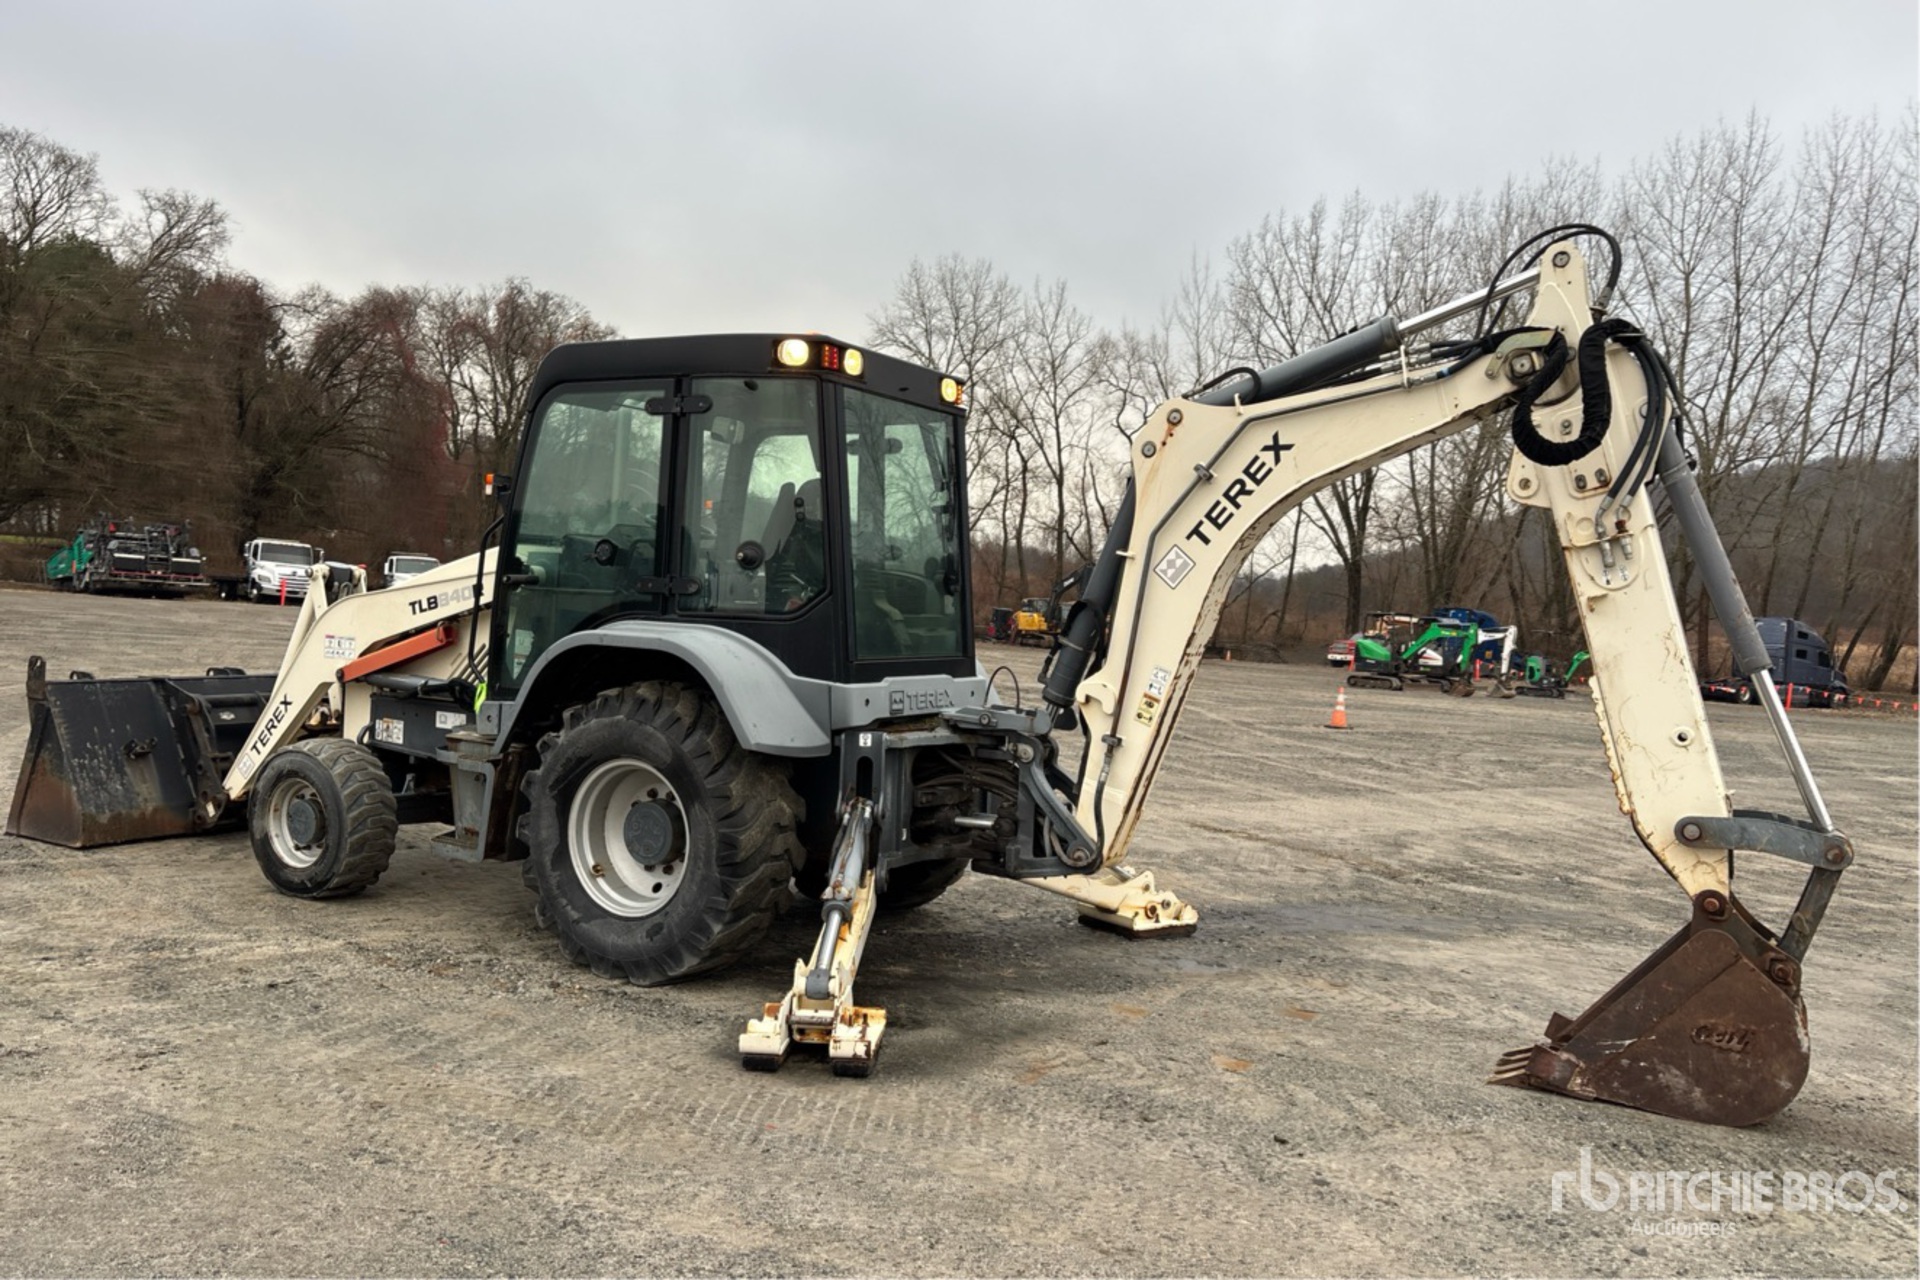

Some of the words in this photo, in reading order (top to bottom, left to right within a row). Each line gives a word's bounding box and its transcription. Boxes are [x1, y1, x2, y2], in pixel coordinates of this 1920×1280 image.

[1185, 430, 1296, 546] TEREX
[250, 693, 293, 755] TEREX
[906, 689, 955, 711] TEREX
